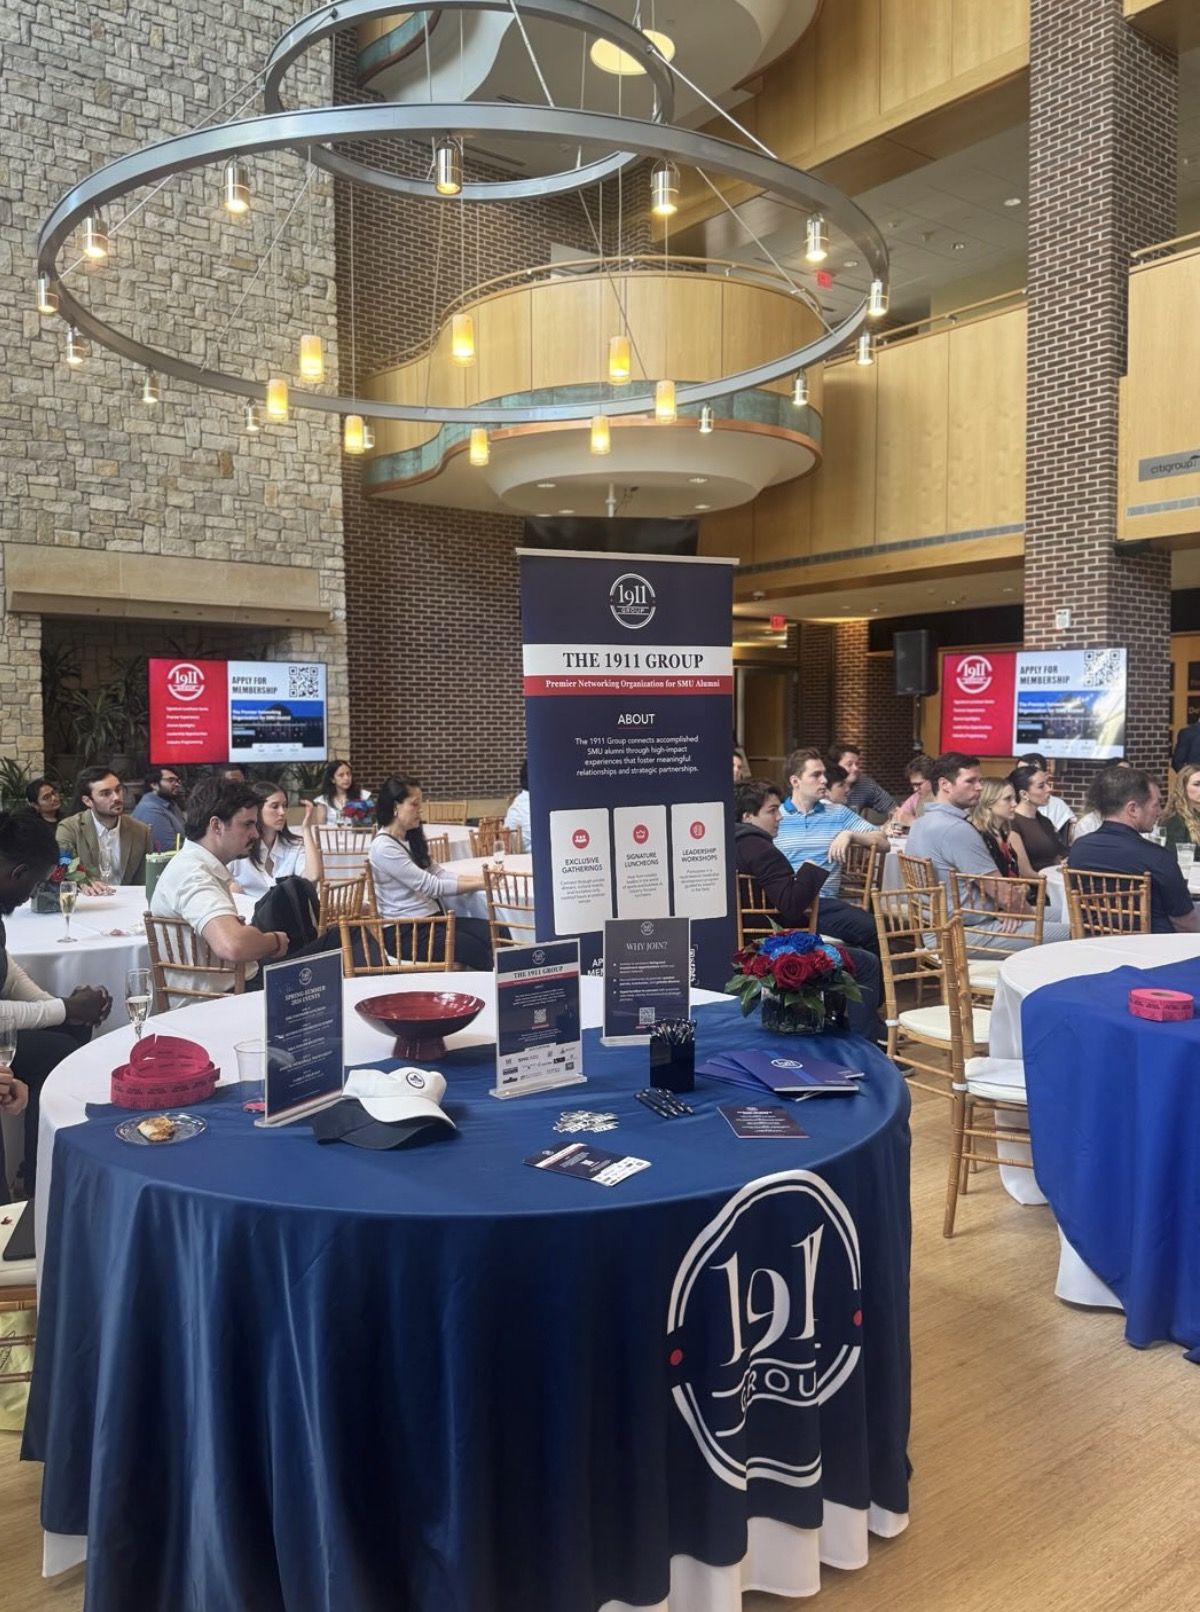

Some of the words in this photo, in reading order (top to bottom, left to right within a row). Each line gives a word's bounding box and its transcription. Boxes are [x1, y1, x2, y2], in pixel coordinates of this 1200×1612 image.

[1150, 460, 1193, 475] citigroup
[617, 584, 647, 606] 1911
[563, 652, 600, 668] THE
[605, 653, 640, 669] 1911
[645, 653, 704, 669] GROUP
[963, 663, 985, 679] 1911
[1020, 666, 1042, 675] APPLY
[1043, 665, 1058, 674] FOR
[175, 671, 198, 685] 1911
[232, 676, 252, 685] APPLY
[253, 676, 267, 685] FOR
[1020, 675, 1070, 685] MEMBERSHIP
[545, 679, 576, 688] Premier
[578, 679, 620, 689] Networking
[620, 679, 664, 689] Organization
[665, 679, 676, 688] for
[677, 679, 694, 688] SMU
[696, 679, 720, 688] Alumni
[232, 686, 278, 695] MEMBERSHIP
[617, 713, 656, 725] ABOUT
[575, 737, 588, 745] The
[589, 737, 605, 745] 1911
[607, 736, 627, 746] Group
[627, 736, 655, 744] connects
[656, 735, 699, 744] accomplished
[587, 747, 603, 756] SMU
[604, 747, 625, 755] alumni
[625, 746, 650, 756] through
[650, 746, 688, 755] high-impact
[584, 757, 623, 766] experiences
[623, 756, 636, 764] that
[637, 756, 655, 764] foster
[656, 754, 691, 764] meaningful
[576, 767, 617, 777] relationships
[618, 767, 630, 775] and
[631, 766, 658, 776] strategic
[626, 852, 657, 861] SIGNATURE
[682, 848, 716, 856] LEADERSHIP
[564, 857, 599, 866] EXCLUSIVE
[624, 859, 659, 868] LUNCHEONS
[681, 855, 717, 863] WORKSHOPS
[561, 864, 603, 874] GATHERINGS
[626, 943, 645, 951] WHY
[646, 941, 668, 951] JOIN?
